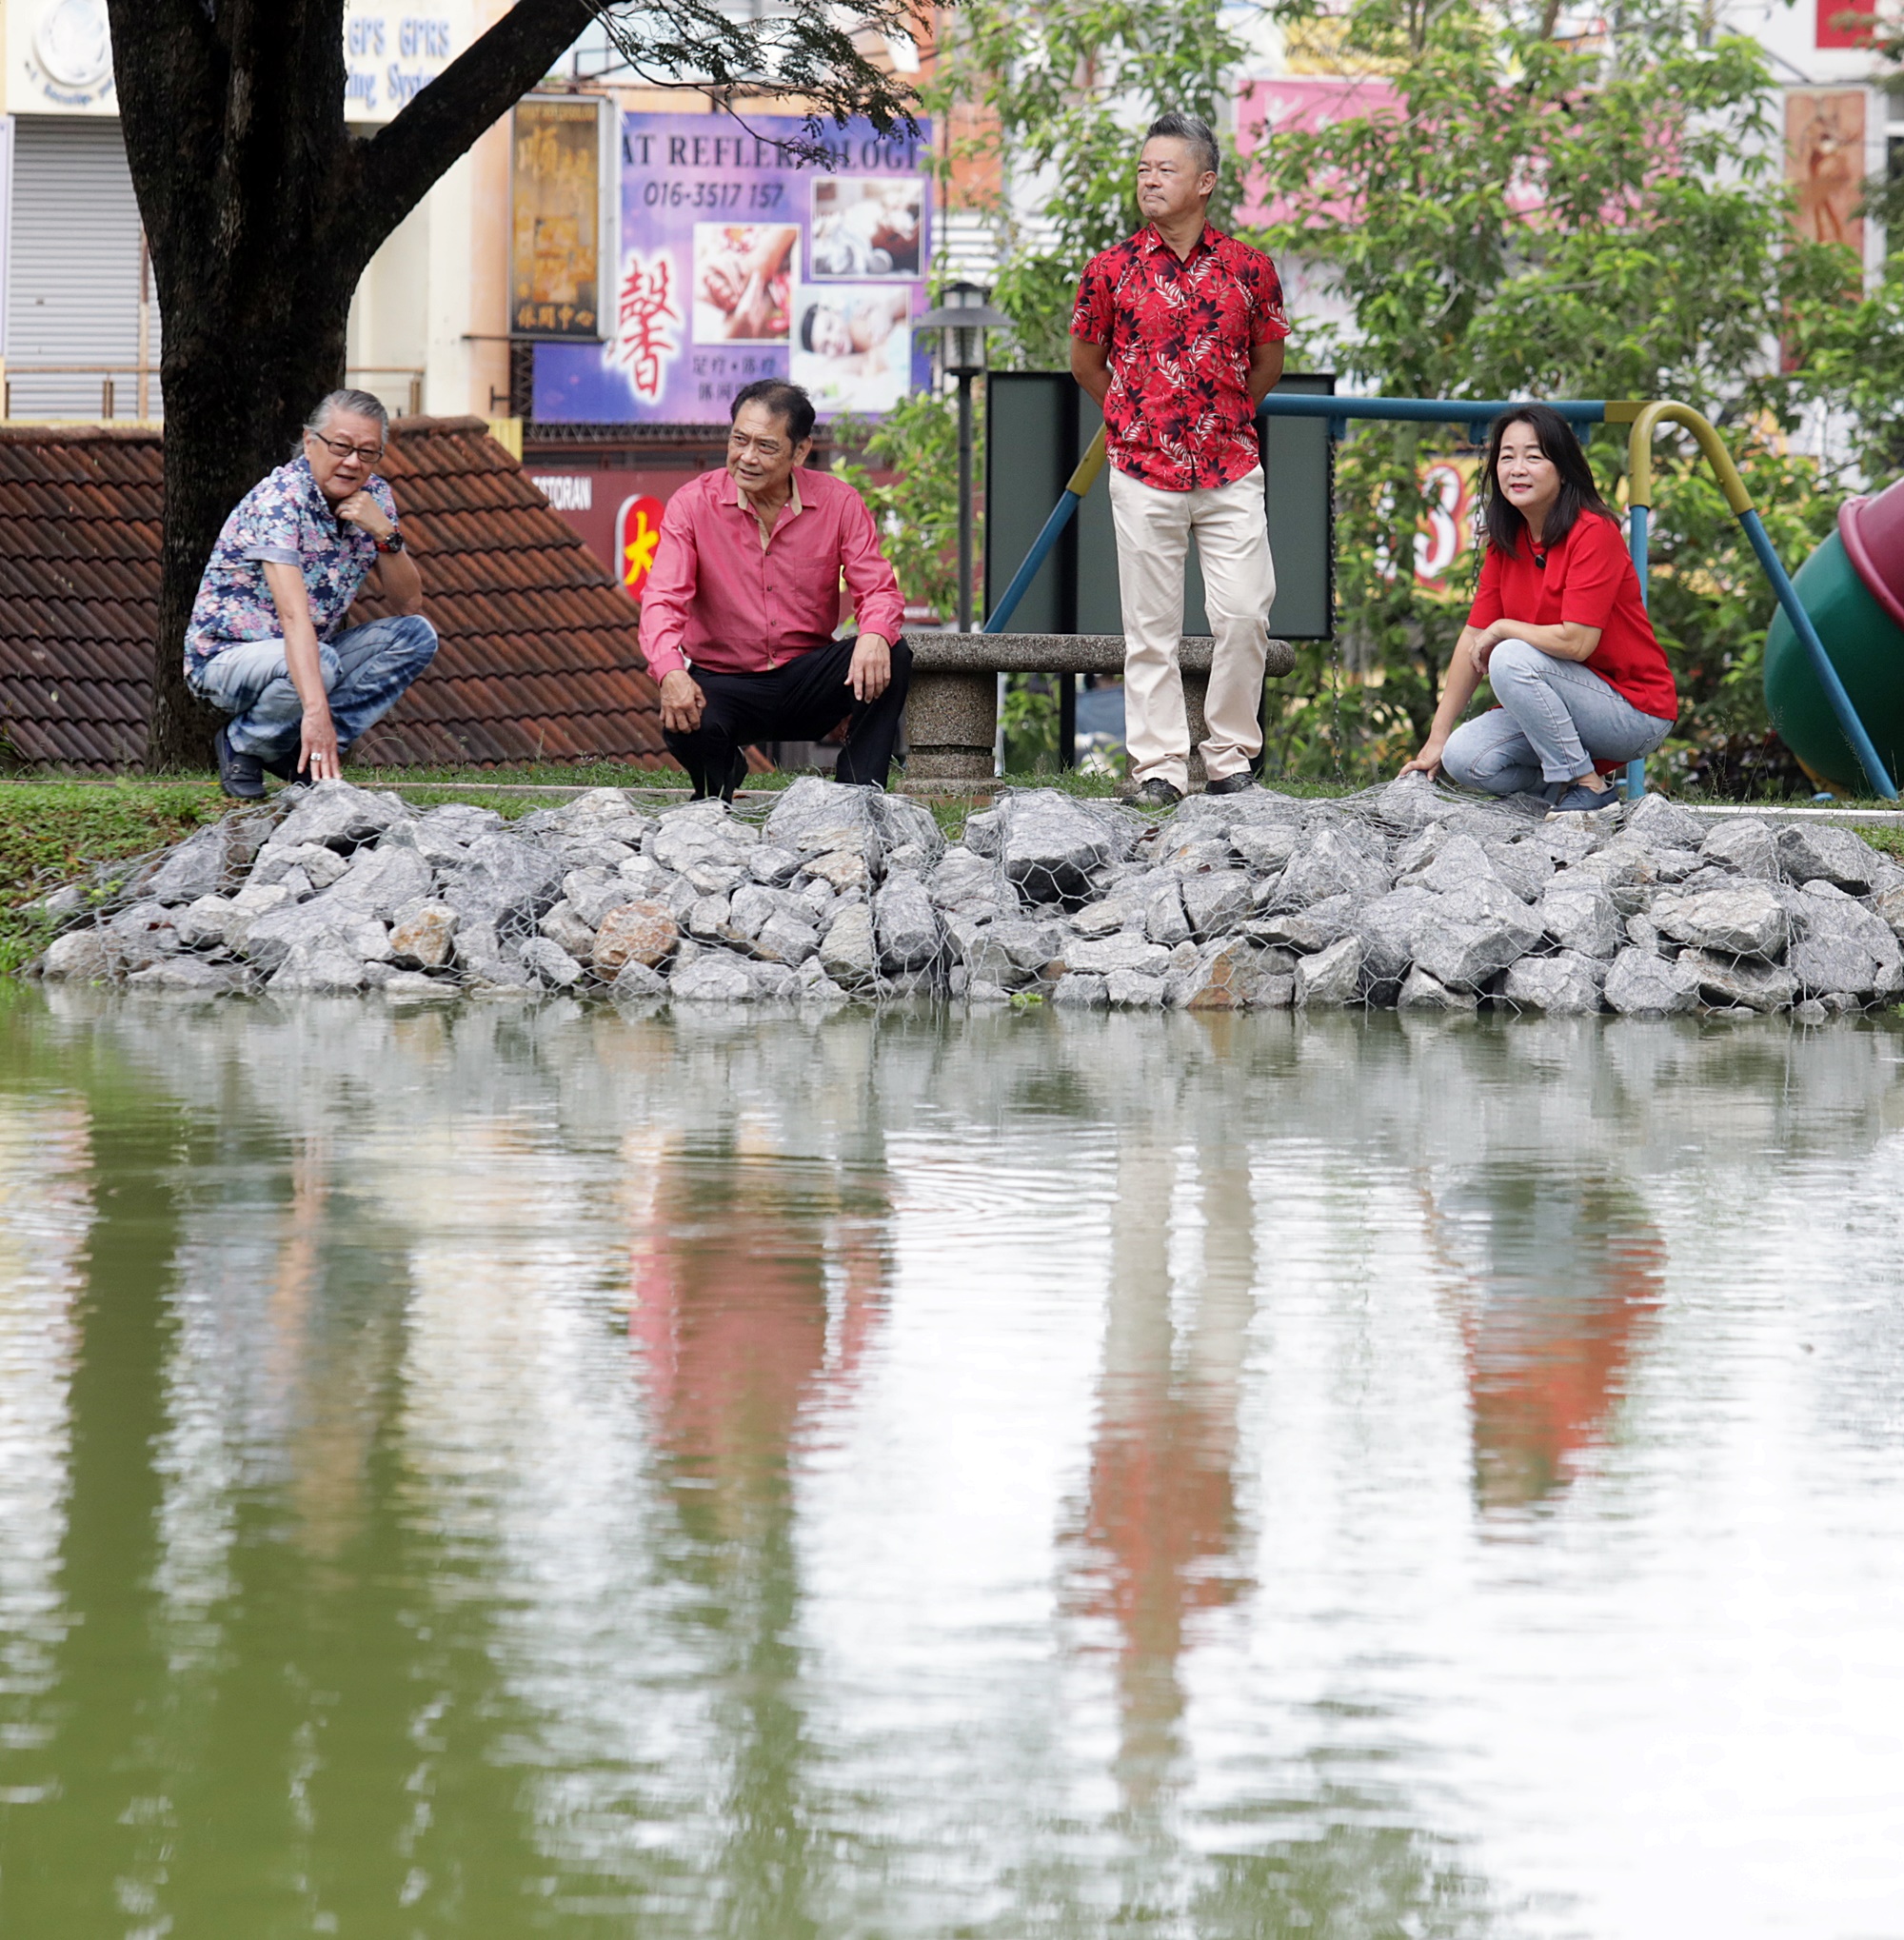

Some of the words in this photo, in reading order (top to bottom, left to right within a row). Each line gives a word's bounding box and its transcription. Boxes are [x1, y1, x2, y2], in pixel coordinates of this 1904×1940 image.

[348, 17, 386, 55] GPS
[399, 18, 450, 57] GPRS
[347, 65, 377, 109] ing
[749, 183, 784, 208] 157
